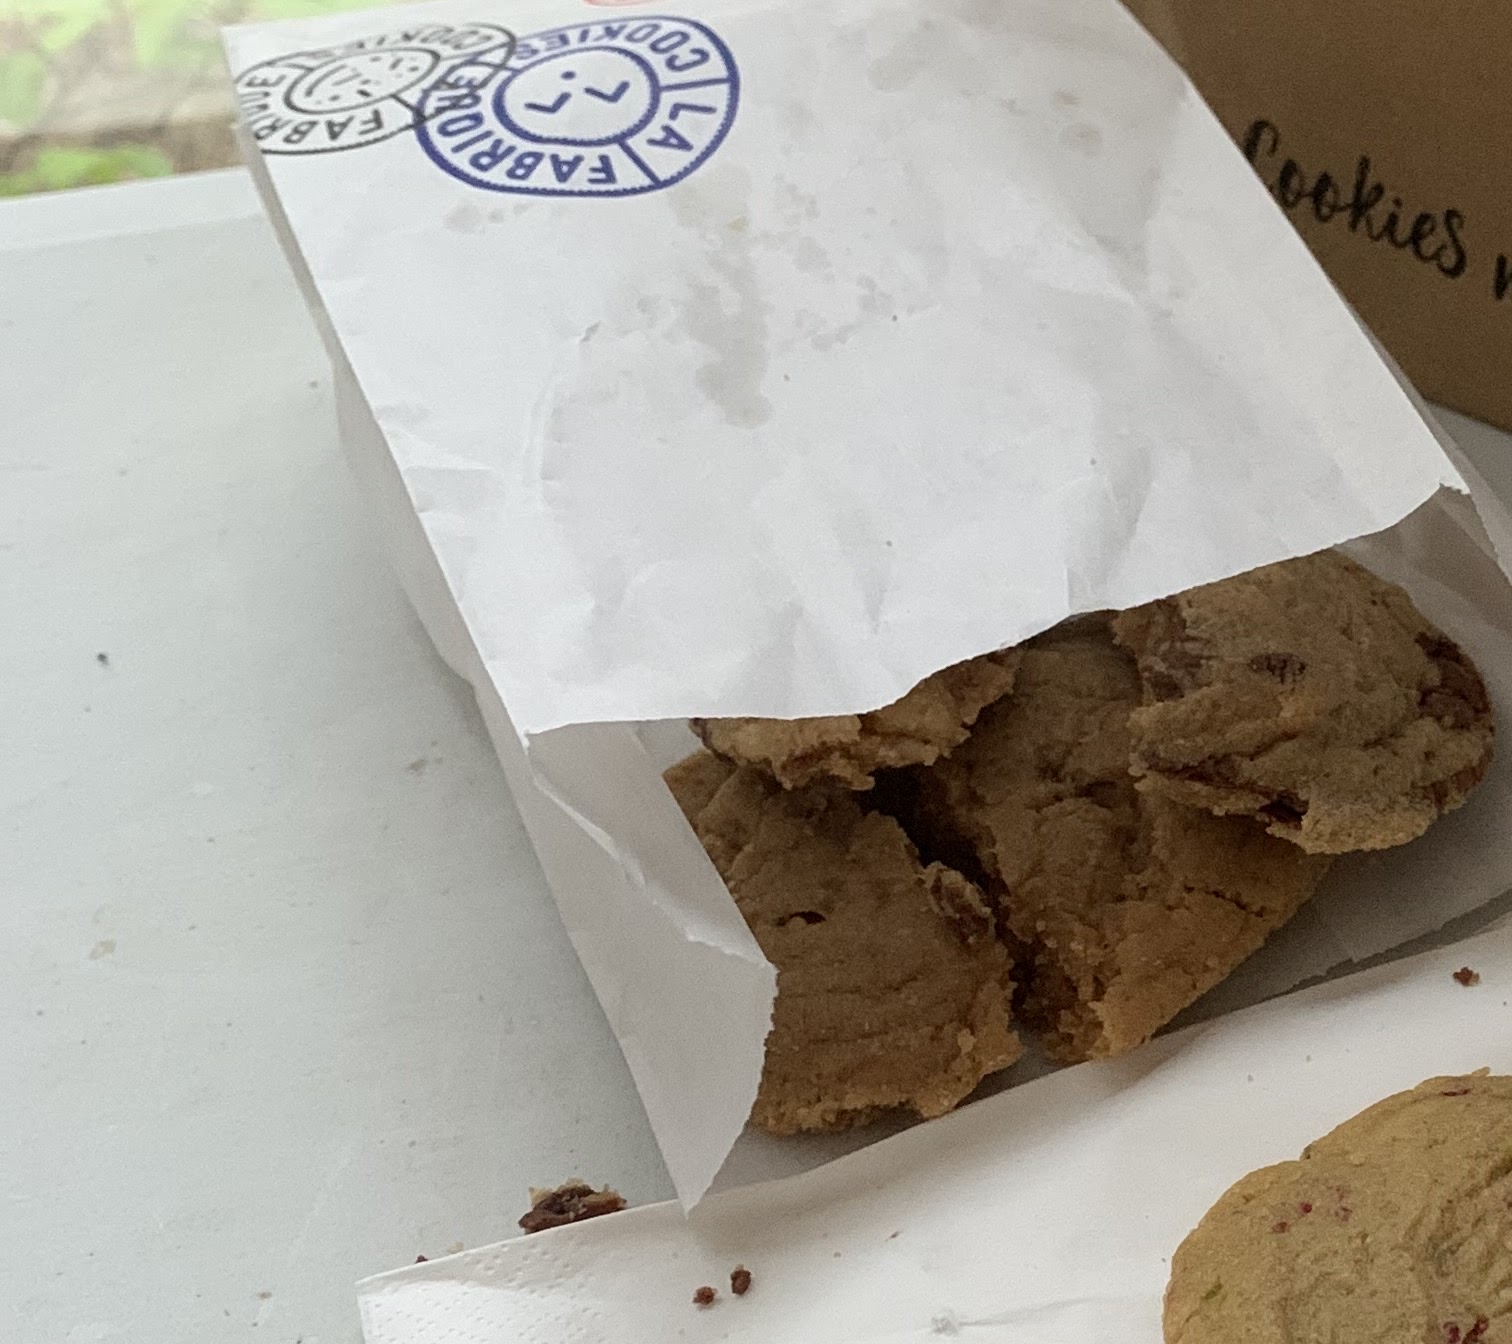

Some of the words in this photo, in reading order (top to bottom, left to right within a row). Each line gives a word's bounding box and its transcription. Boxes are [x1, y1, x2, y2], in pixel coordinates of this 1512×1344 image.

[516, 22, 711, 73] COOKIES
[646, 102, 718, 153] LA
[1243, 118, 1468, 279] Cookies
